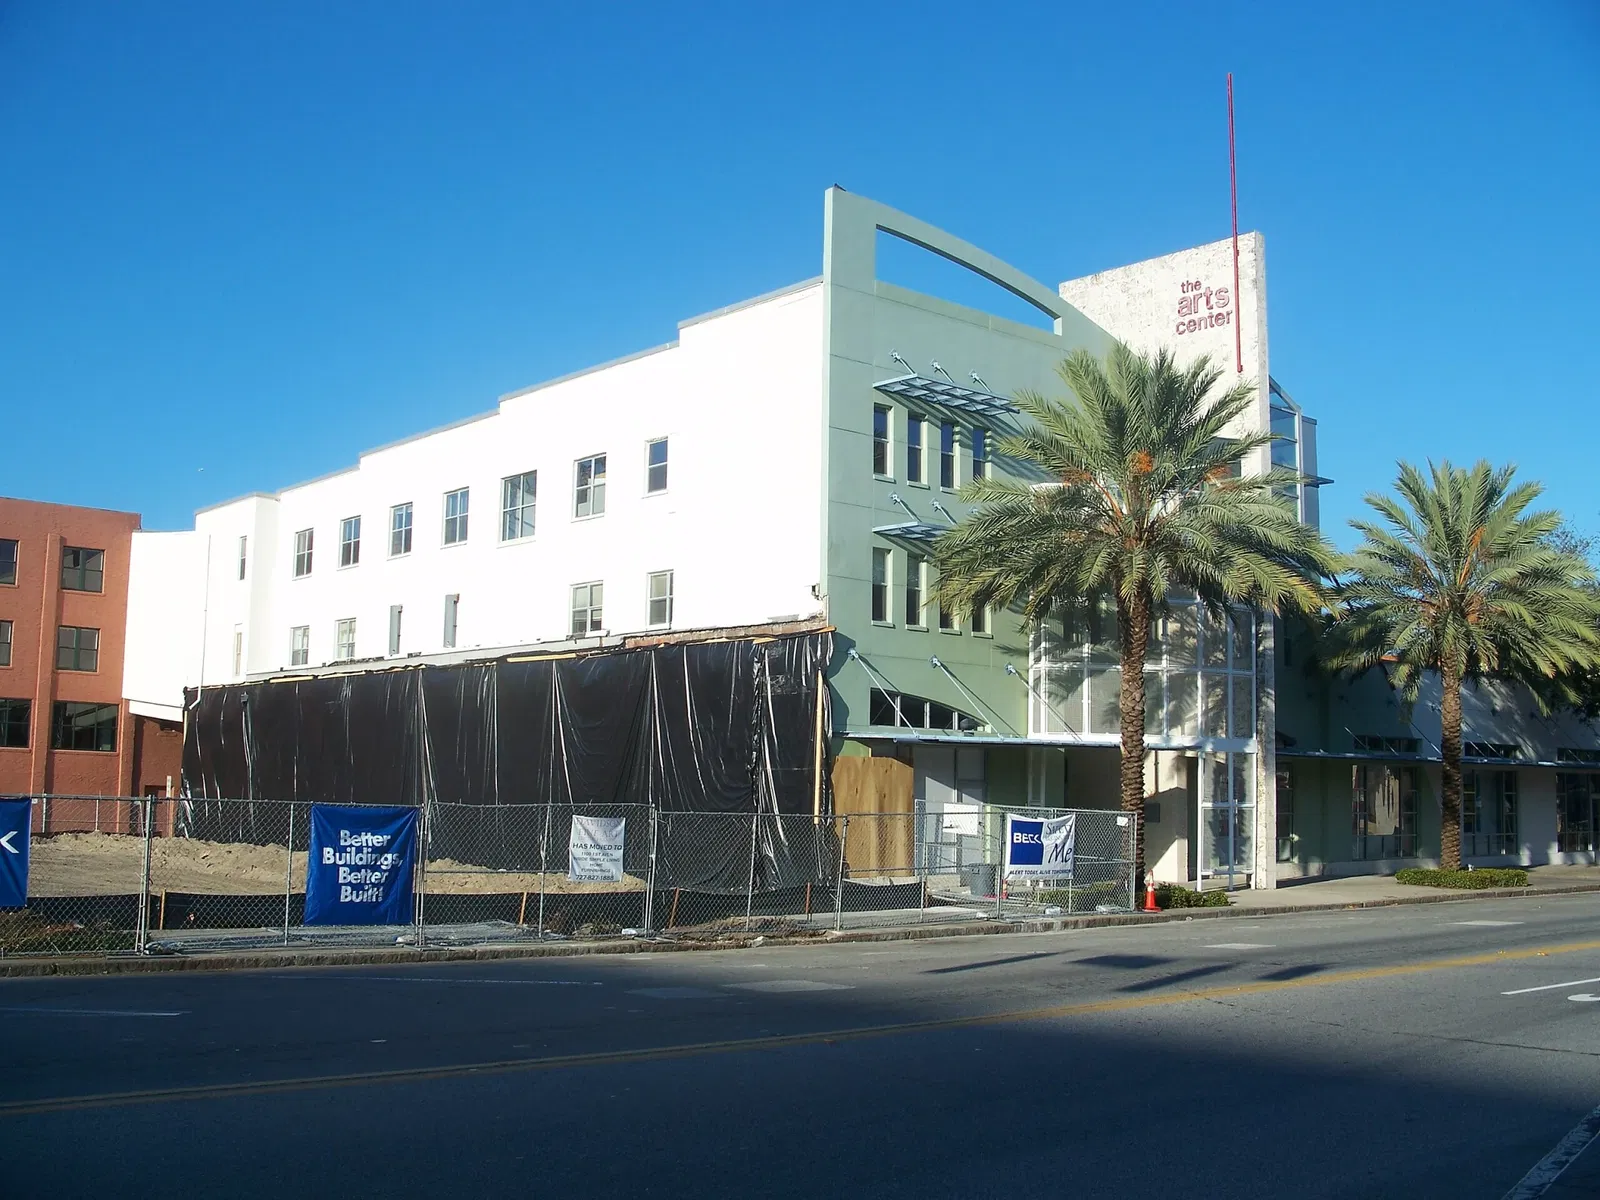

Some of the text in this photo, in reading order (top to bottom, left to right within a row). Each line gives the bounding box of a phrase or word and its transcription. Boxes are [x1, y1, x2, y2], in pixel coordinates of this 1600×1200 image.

[1181, 280, 1202, 293] the
[1178, 286, 1230, 317] arts
[1176, 310, 1233, 335] center
[340, 829, 391, 847] Better
[1013, 832, 1042, 844] BECK
[322, 847, 404, 870] Buildings,
[1047, 843, 1073, 864] Me
[338, 867, 389, 884] Better
[340, 885, 384, 902] Built!
